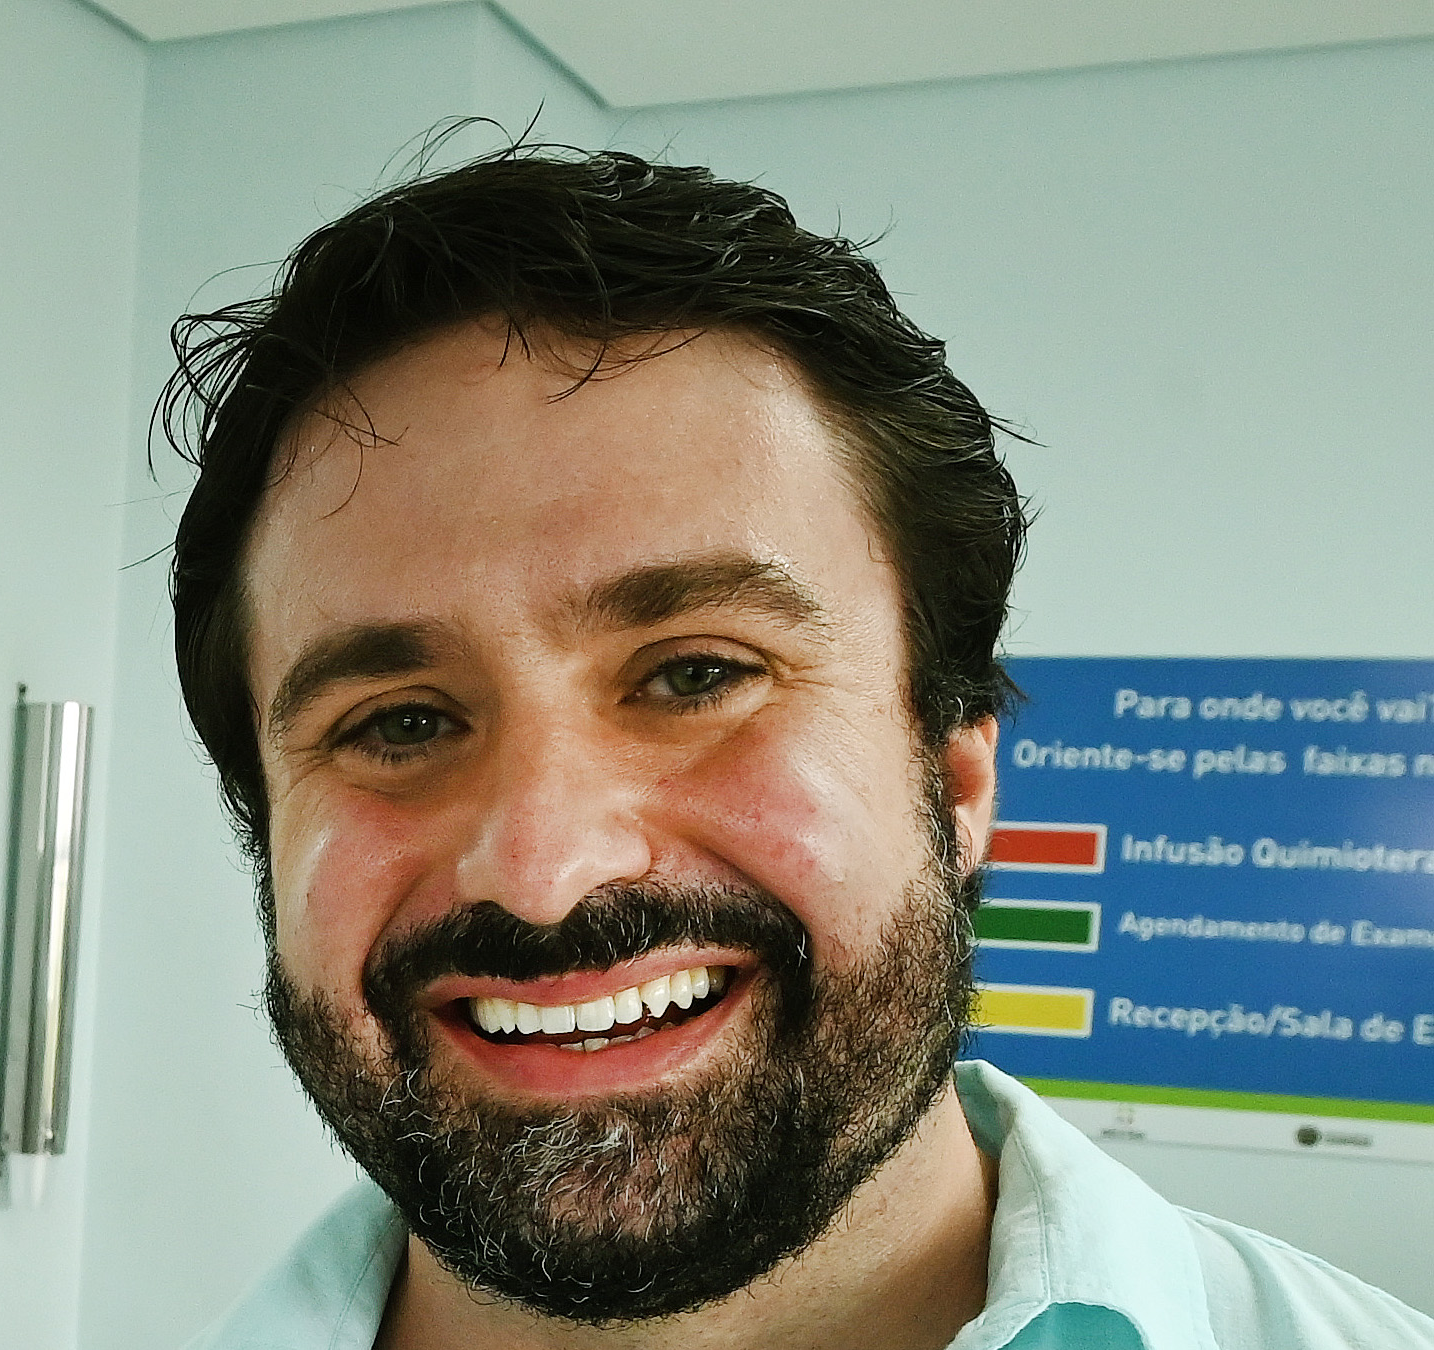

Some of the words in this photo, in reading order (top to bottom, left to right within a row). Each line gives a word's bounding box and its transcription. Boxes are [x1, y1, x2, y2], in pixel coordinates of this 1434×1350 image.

[1116, 689, 1191, 718] Para
[1199, 693, 1283, 720] onde
[1290, 690, 1369, 722] você
[1014, 739, 1186, 772] Oriente-se
[1193, 746, 1286, 778] pelas
[1122, 835, 1245, 866] Infusão
[1119, 912, 1305, 942] Agendamento
[1309, 919, 1345, 945] de
[1351, 920, 1434, 947] Exam
[1359, 1014, 1404, 1042] de
